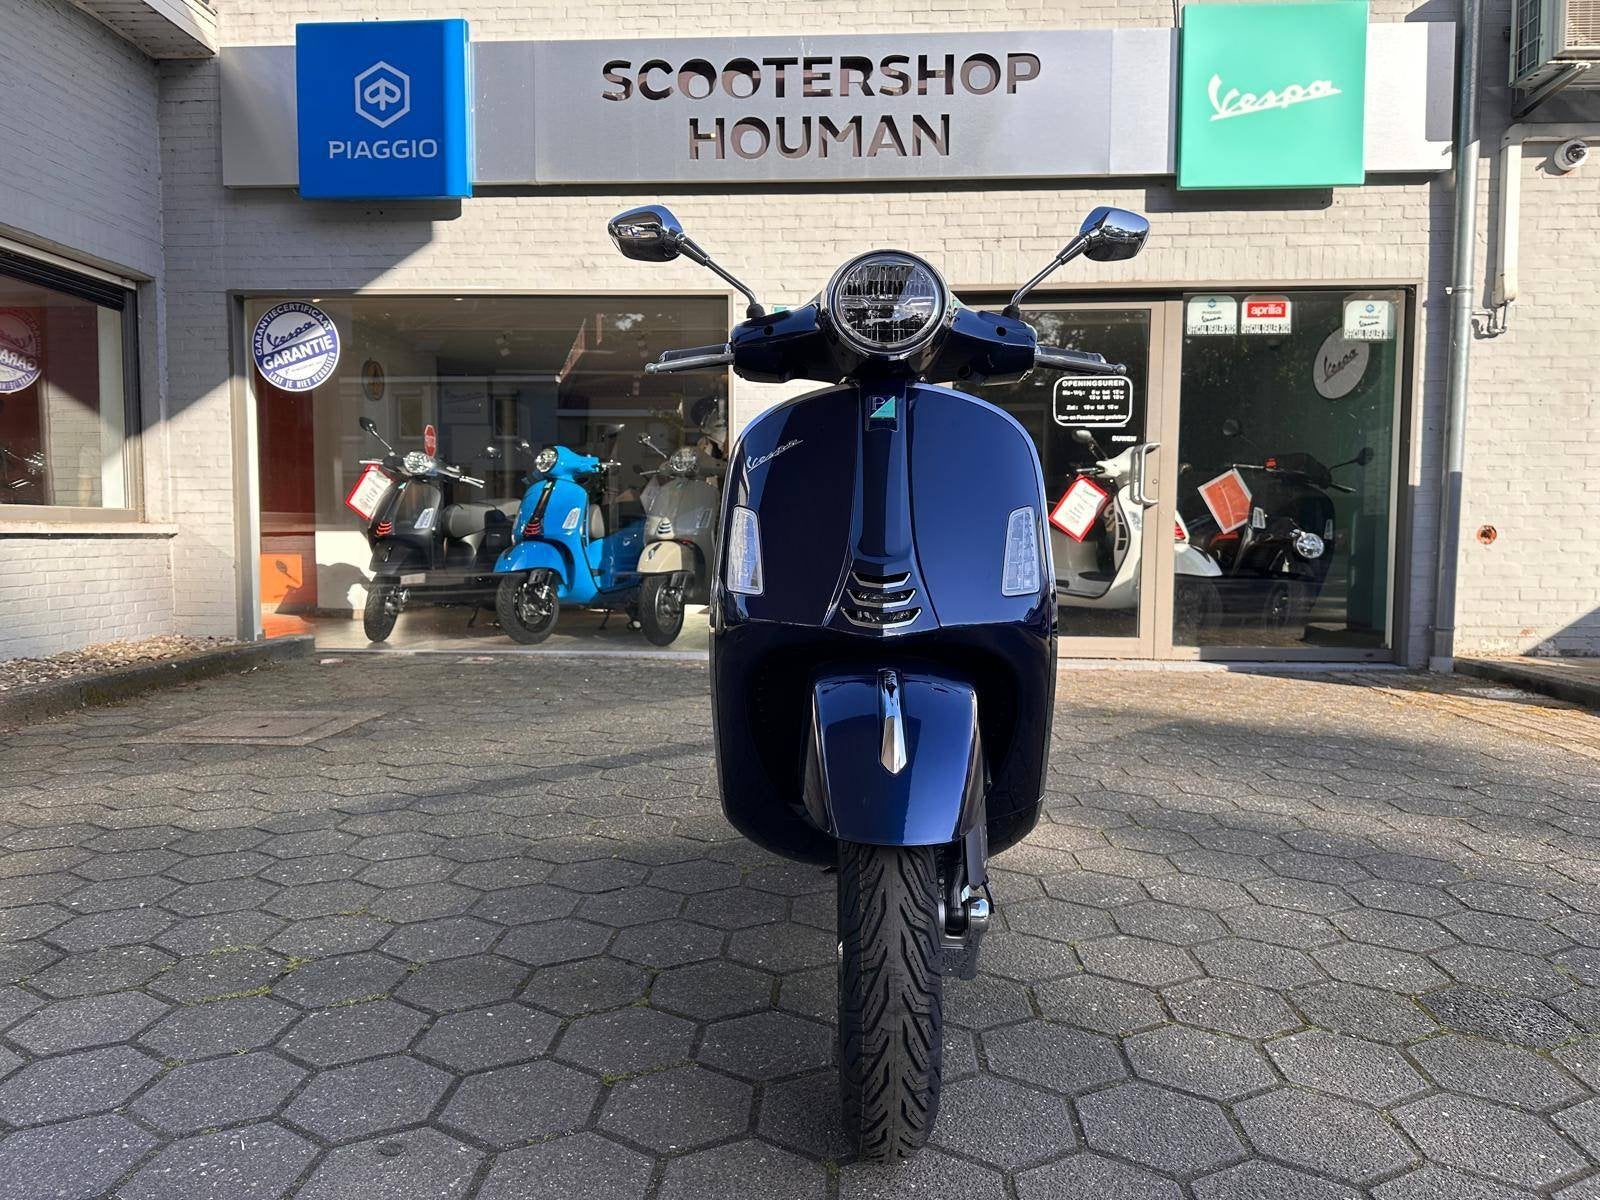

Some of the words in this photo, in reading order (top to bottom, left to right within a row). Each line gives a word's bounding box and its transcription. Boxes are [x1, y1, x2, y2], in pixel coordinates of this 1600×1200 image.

[602, 52, 1041, 101] SCOOTERSHOP
[1207, 73, 1342, 122] Vespa
[328, 139, 438, 159] PIAGGIO
[689, 113, 950, 160] HOUMAN
[1250, 303, 1282, 317] aprilia
[254, 303, 333, 356] GARANTIECERTIFICAAT
[266, 321, 317, 351] Vespa
[263, 335, 335, 370] GARANTIE
[1323, 348, 1359, 383] Vespa
[286, 380, 294, 389] JE
[296, 379, 312, 389] NIET
